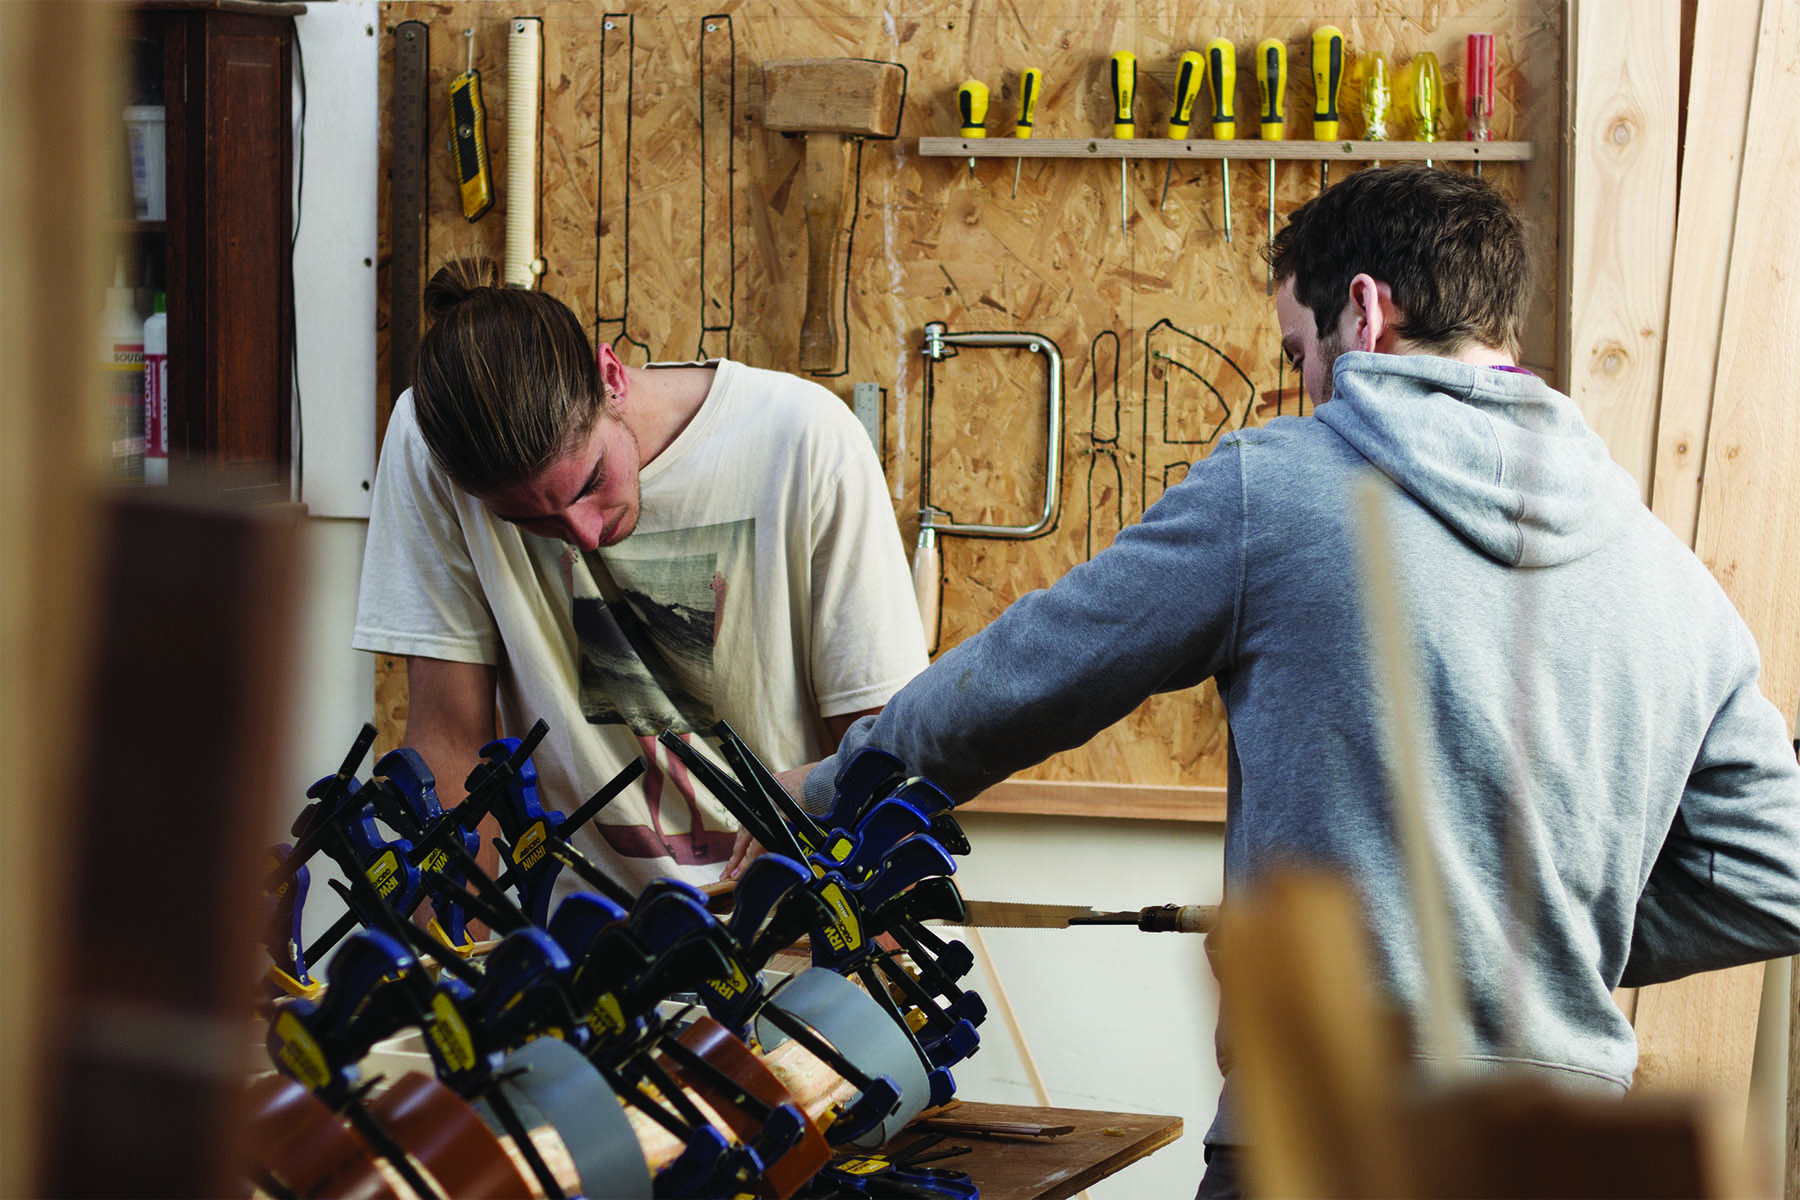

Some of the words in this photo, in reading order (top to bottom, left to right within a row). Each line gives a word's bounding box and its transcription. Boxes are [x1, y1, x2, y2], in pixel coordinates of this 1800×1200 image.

[432, 852, 448, 872] WIN
[522, 845, 546, 871] IRWIN
[379, 876, 399, 899] IRW
[822, 926, 845, 952] IRW
[706, 979, 735, 1000] IRW
